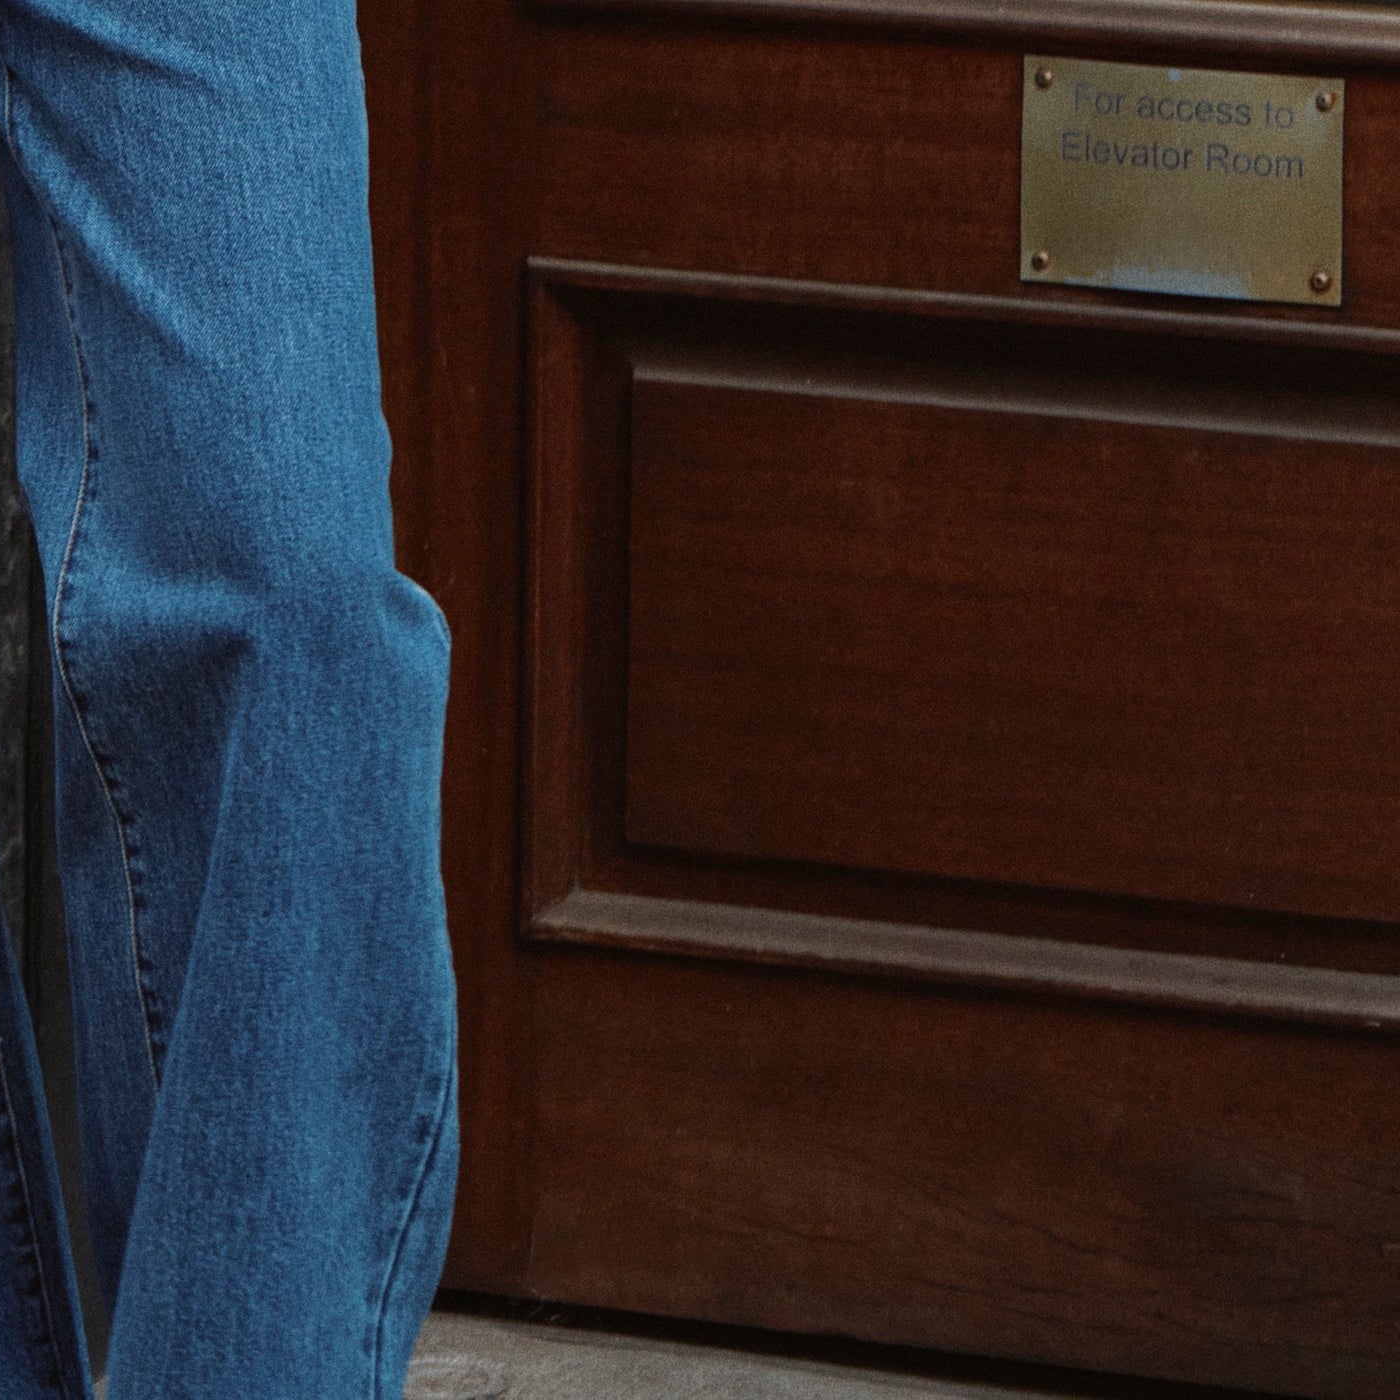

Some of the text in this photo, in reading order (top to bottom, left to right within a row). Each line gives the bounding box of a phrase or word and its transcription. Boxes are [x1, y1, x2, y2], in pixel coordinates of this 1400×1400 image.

[1072, 83, 1295, 130] For access to
[1060, 130, 1305, 179] Elevator Room
